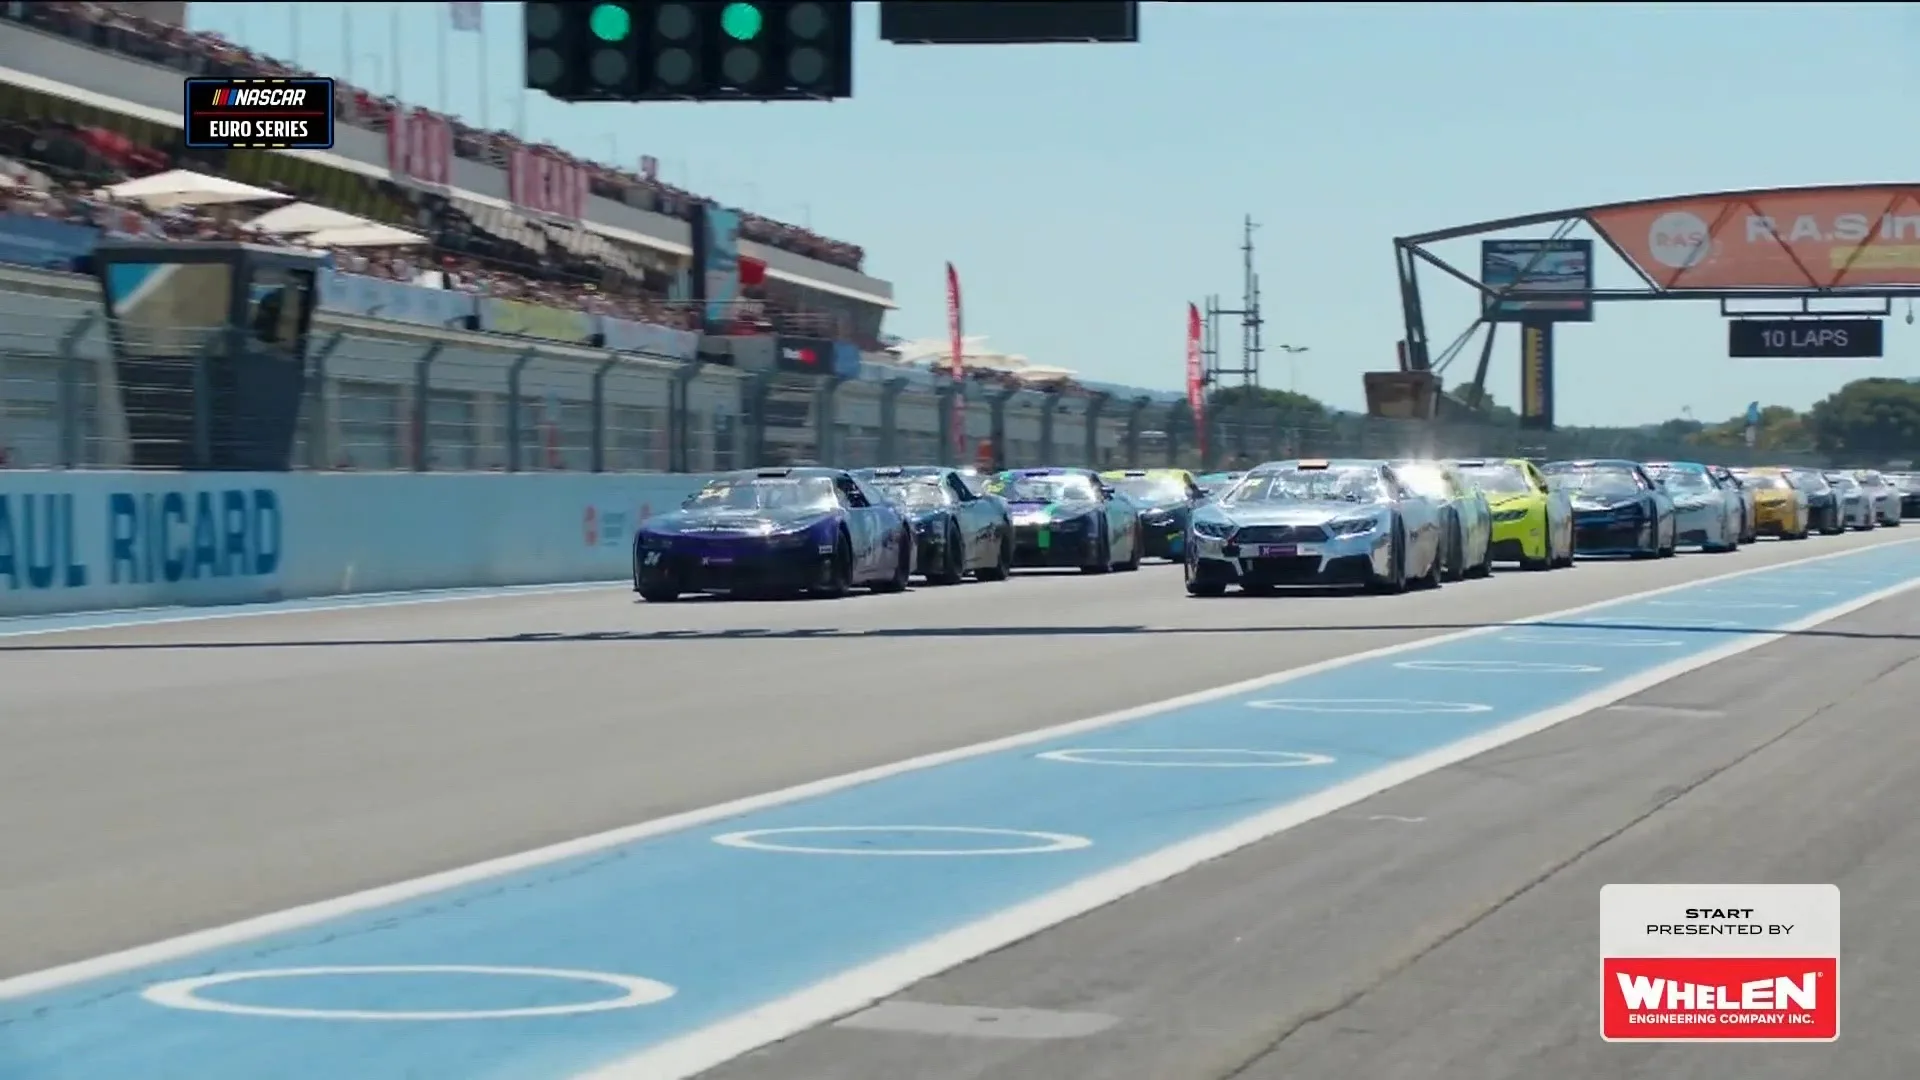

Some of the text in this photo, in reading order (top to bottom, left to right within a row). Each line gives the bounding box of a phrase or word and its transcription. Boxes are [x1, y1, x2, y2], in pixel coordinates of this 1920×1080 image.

[1761, 330, 1849, 347] 10 LAPS
[109, 489, 281, 584] RICARD
